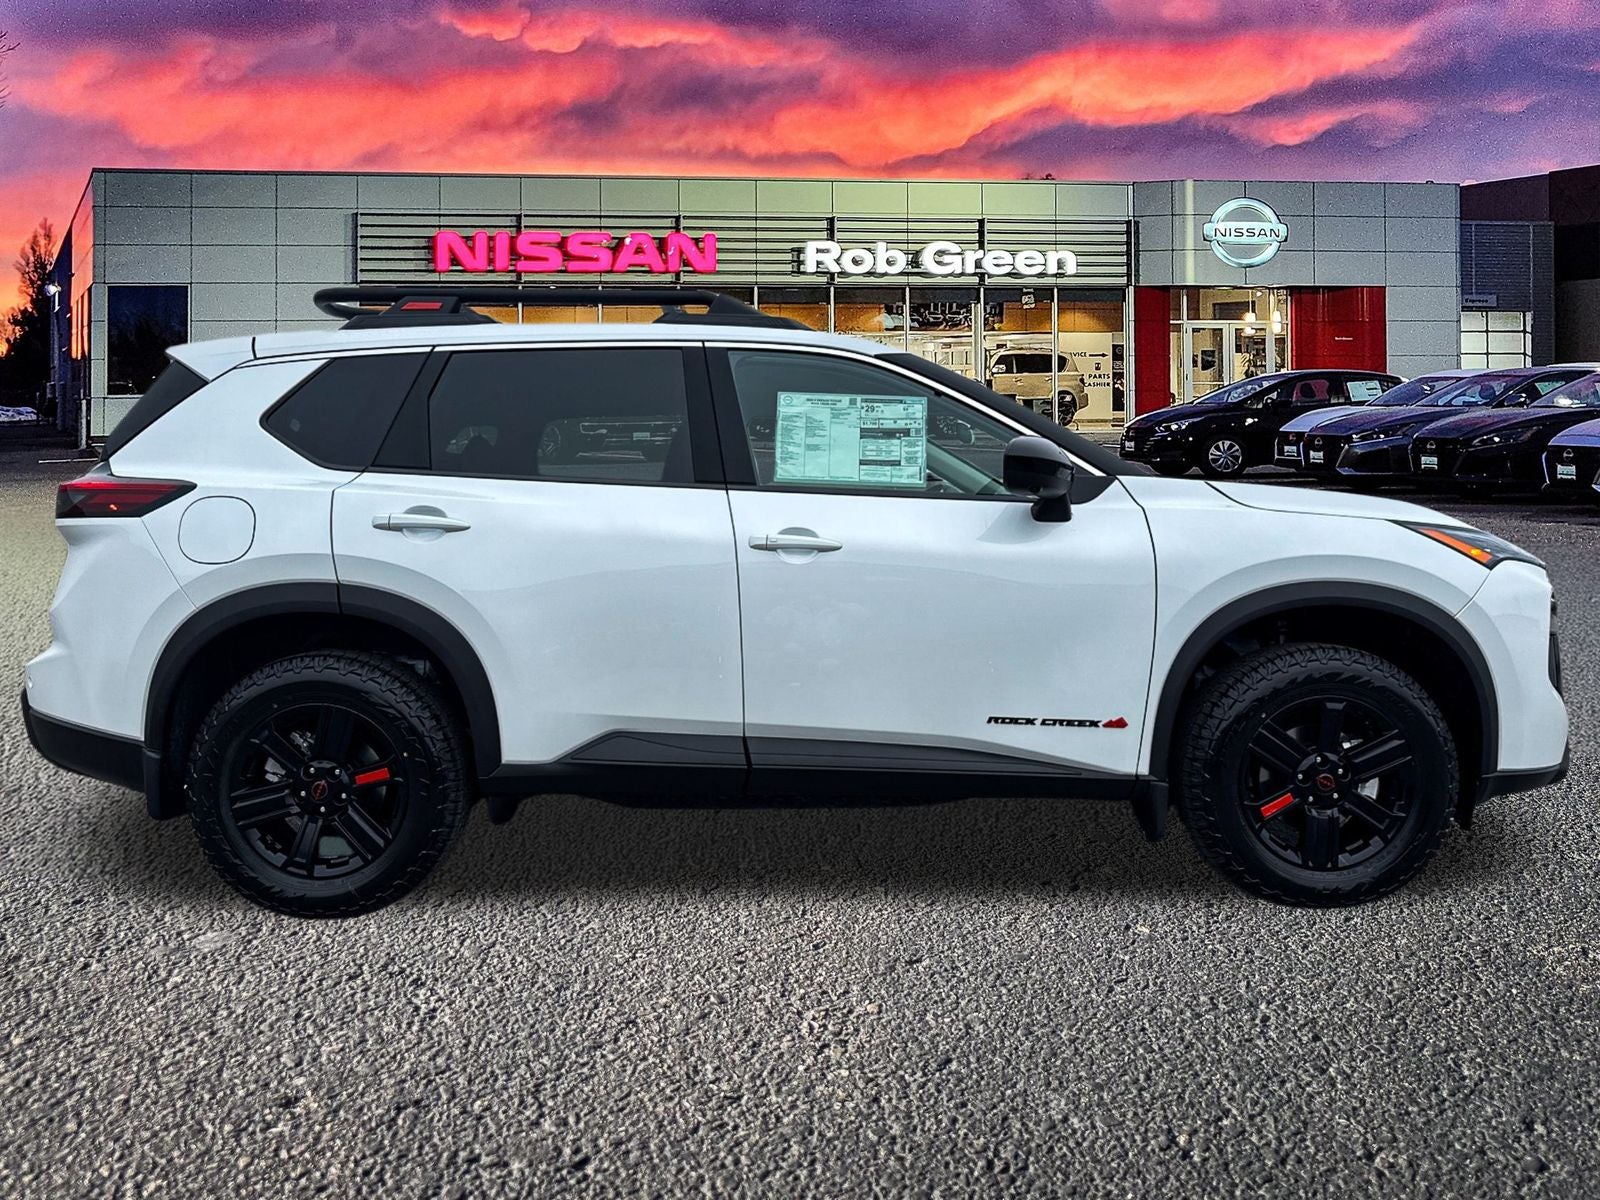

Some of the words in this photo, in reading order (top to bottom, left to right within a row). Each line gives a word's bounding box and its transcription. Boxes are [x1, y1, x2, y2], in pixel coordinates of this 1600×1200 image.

[1214, 227, 1280, 238] NISSAN
[434, 231, 718, 273] NISSAN
[804, 240, 907, 274] Rob
[920, 241, 1078, 275] Green
[986, 716, 1038, 725] ROCK
[1040, 718, 1102, 728] CREEK
